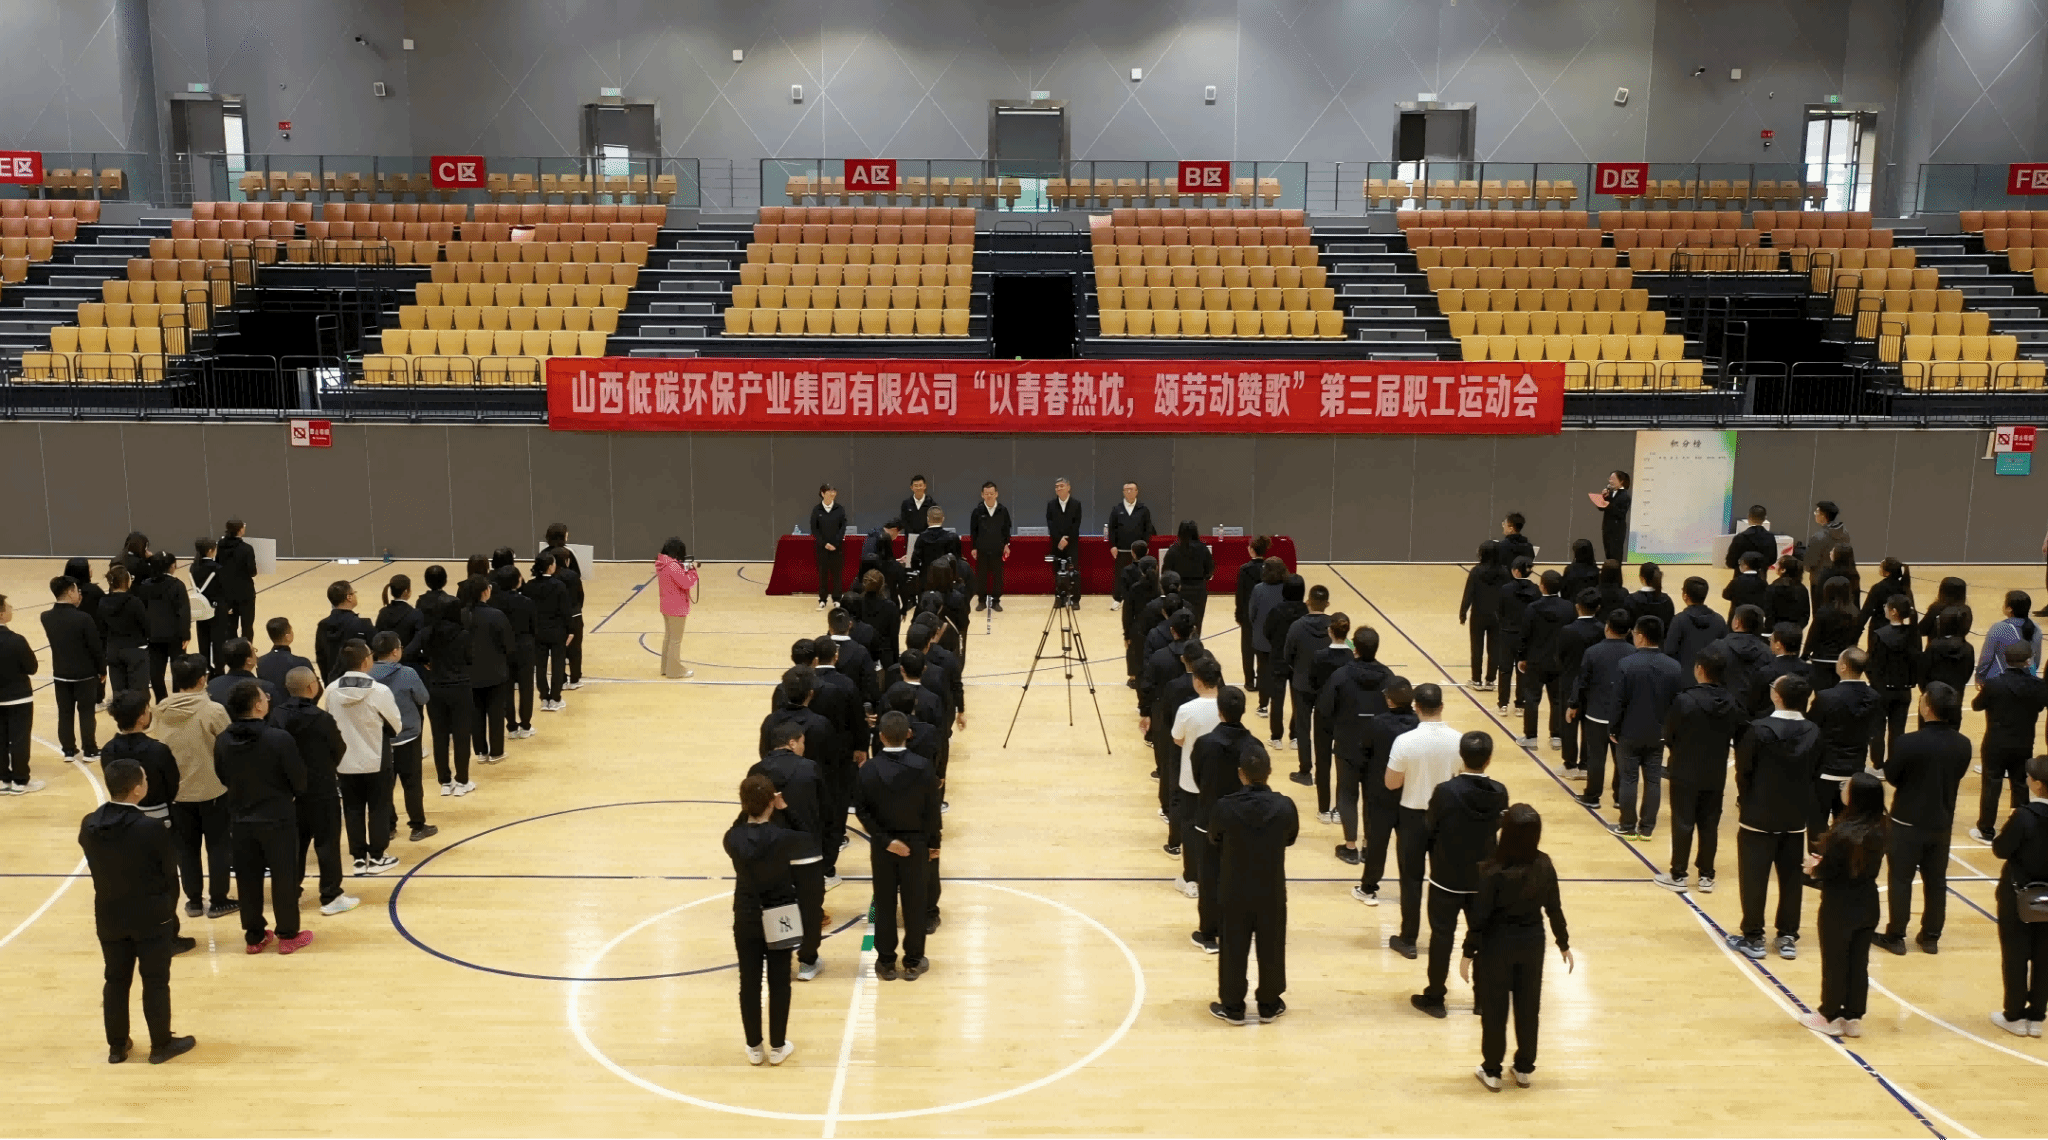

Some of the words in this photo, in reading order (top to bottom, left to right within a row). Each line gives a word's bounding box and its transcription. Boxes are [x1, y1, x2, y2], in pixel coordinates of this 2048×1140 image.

[438, 162, 478, 182] C区
[851, 165, 890, 185] A区
[1185, 167, 1222, 187] B区
[1603, 169, 1640, 188] D区
[2016, 169, 2048, 189] F区
